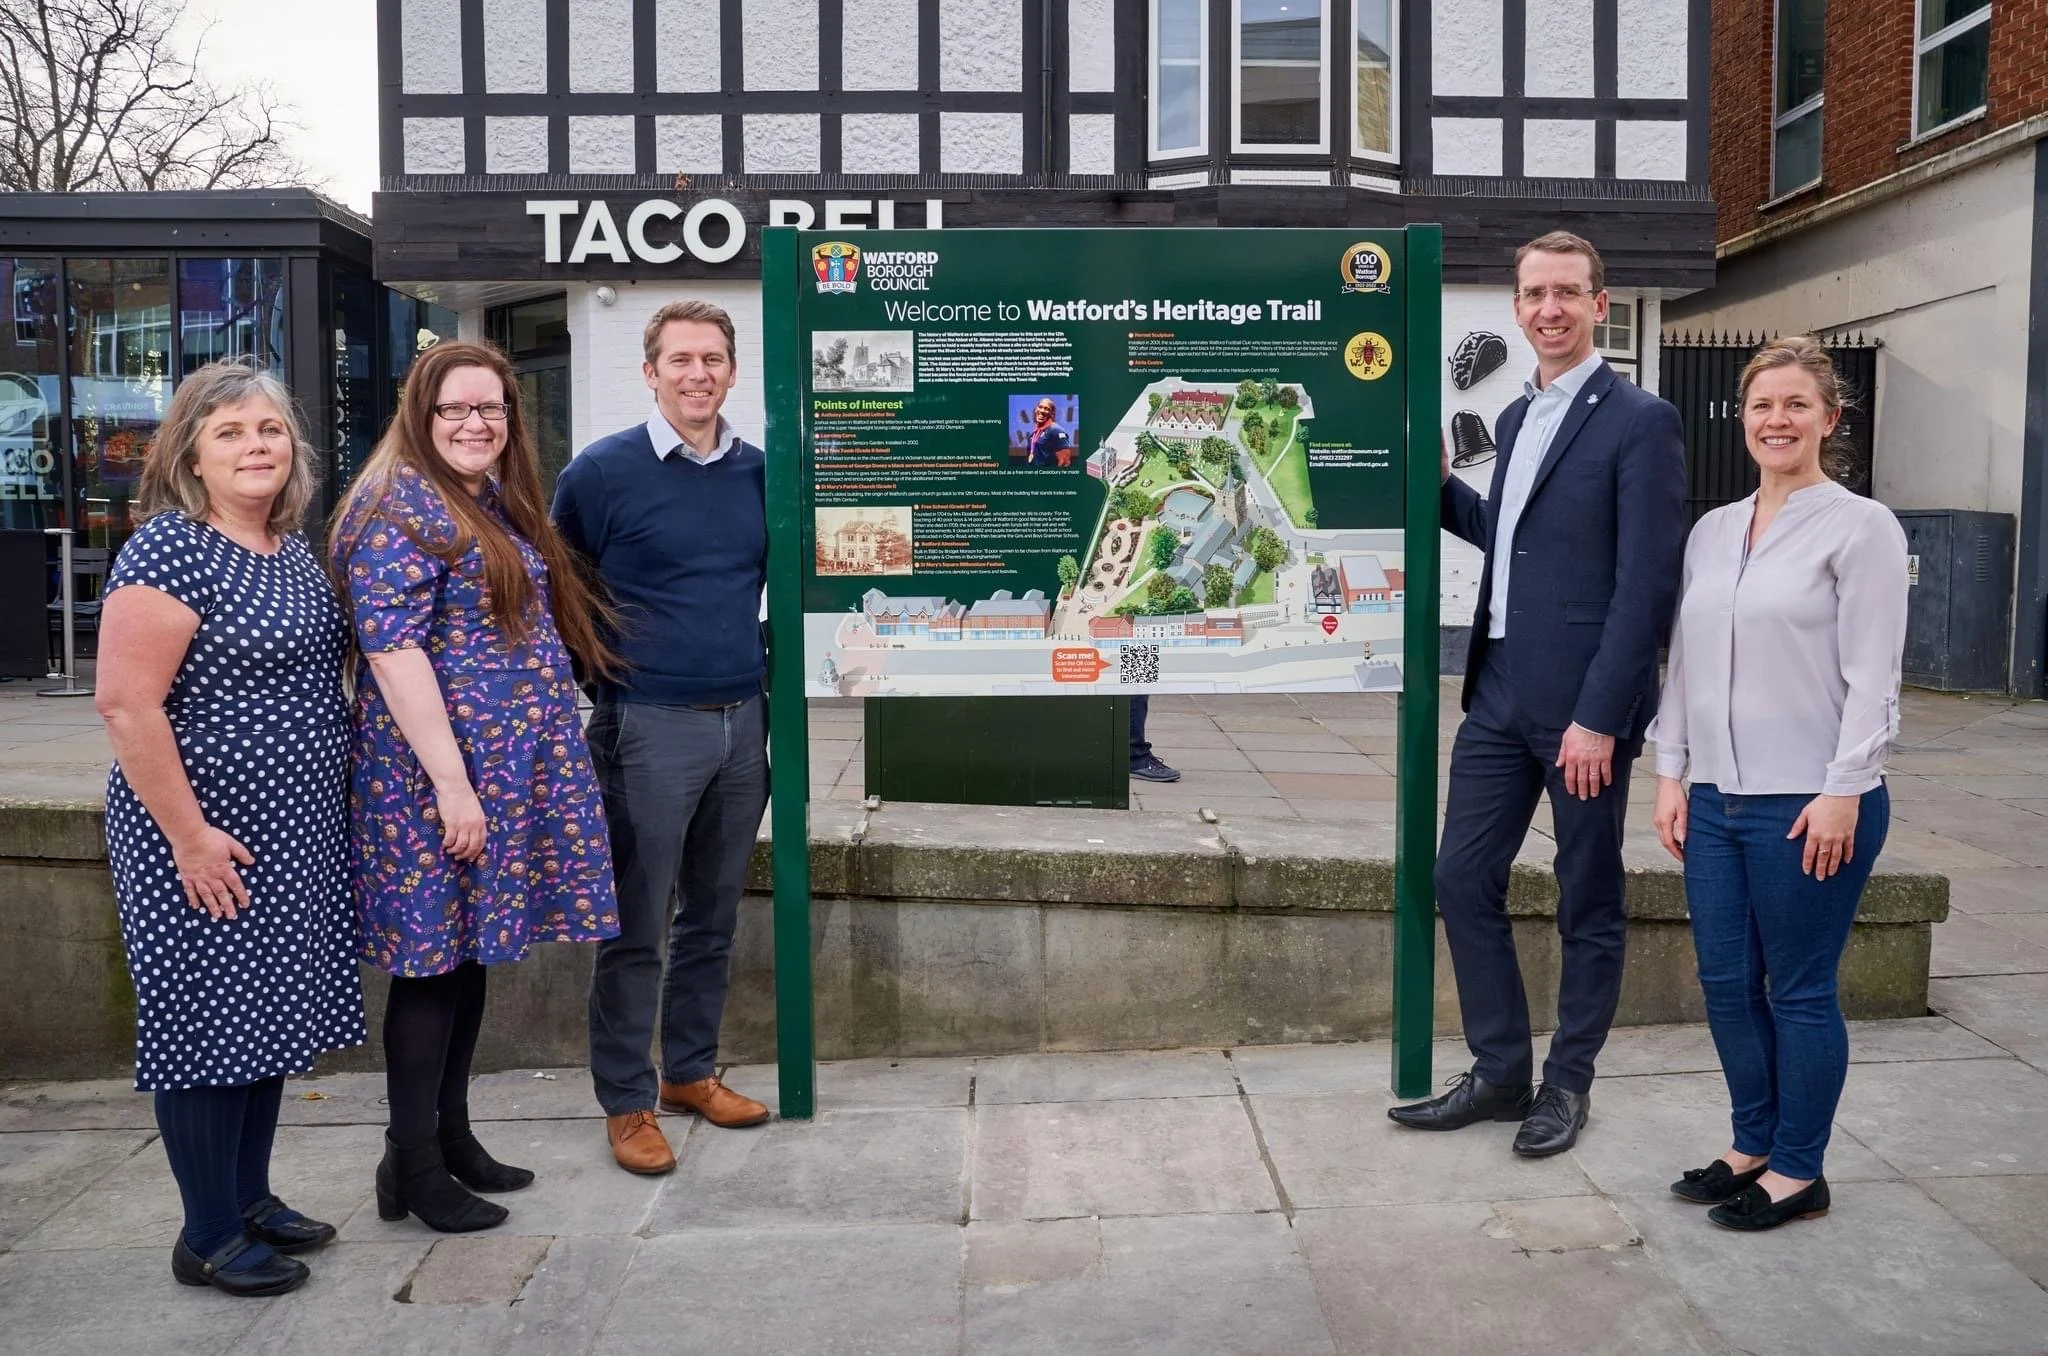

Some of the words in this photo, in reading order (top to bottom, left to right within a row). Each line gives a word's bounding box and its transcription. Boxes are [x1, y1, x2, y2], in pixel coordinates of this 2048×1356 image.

[526, 199, 747, 264] TACO
[862, 252, 938, 264] WATFORD
[1355, 254, 1378, 264] 100
[867, 265, 933, 278] BOROUGH
[870, 278, 930, 290] COUNCIL
[884, 300, 991, 322] Welcome
[998, 301, 1020, 321] to
[1027, 299, 1148, 321] Watford's
[1153, 299, 1262, 325] Heritage
[1266, 299, 1321, 321] Trail
[814, 400, 848, 410] Points
[850, 400, 860, 410] of
[1056, 652, 1077, 660] Scan
[1078, 652, 1095, 660] me!
